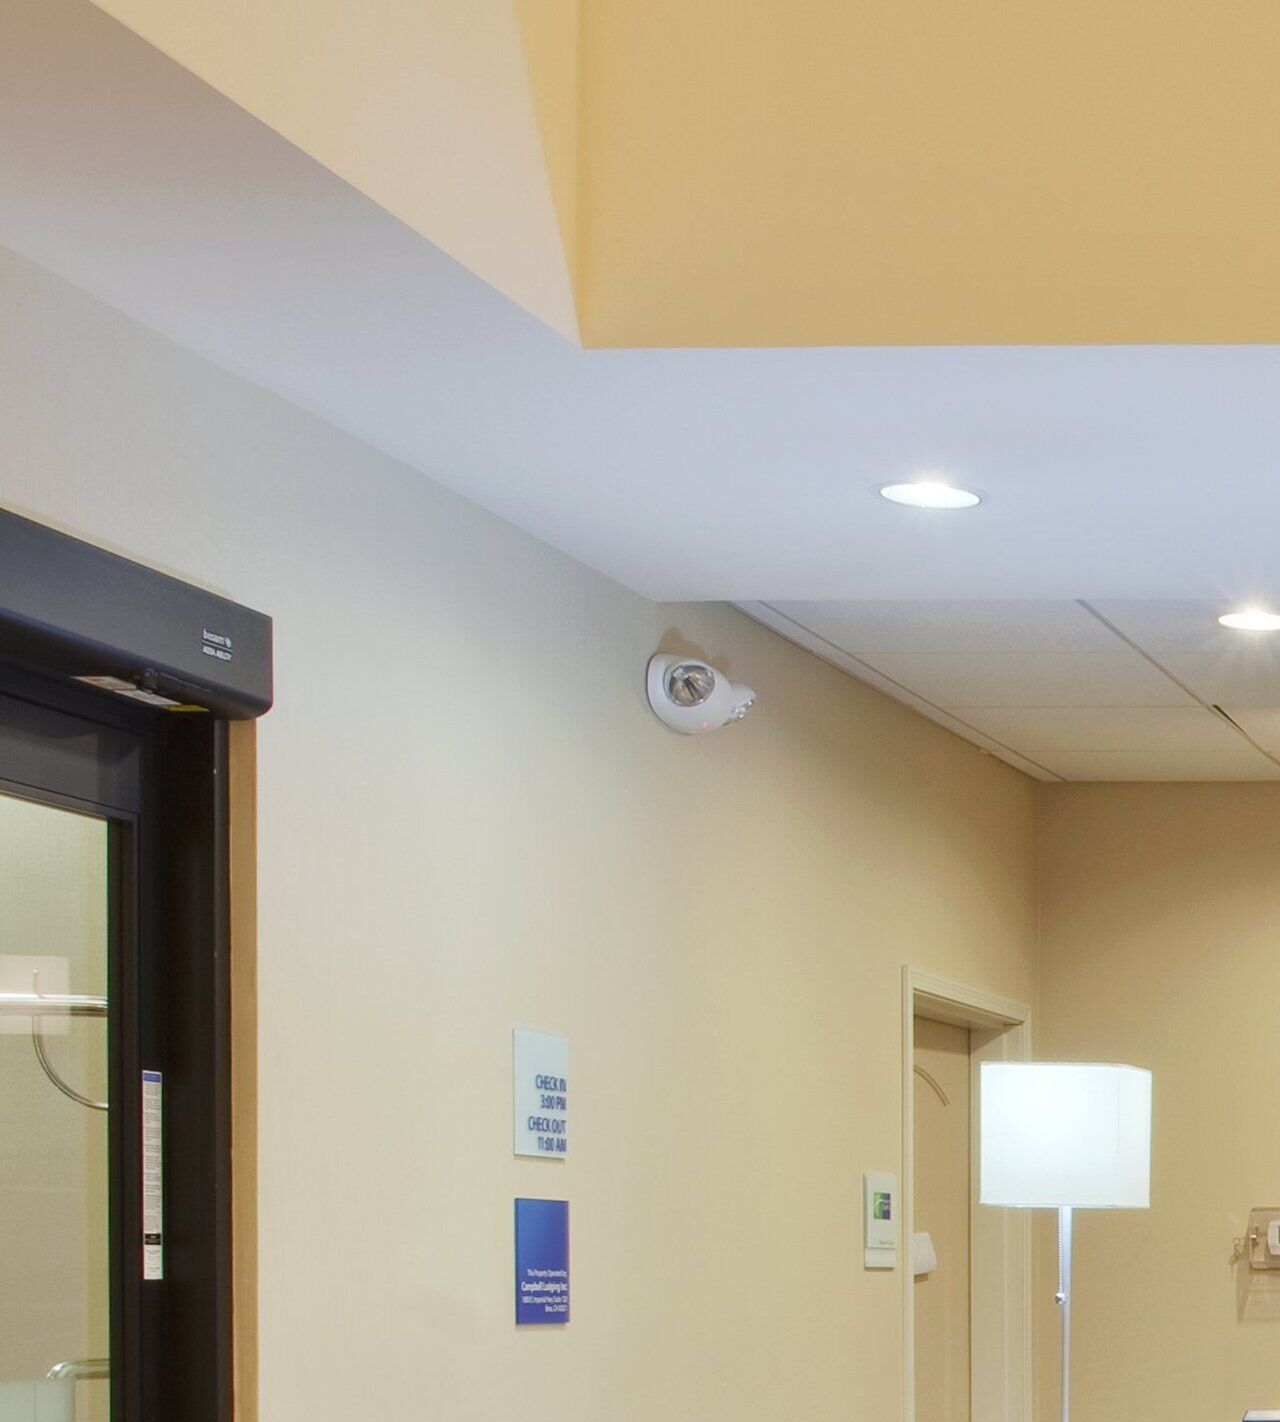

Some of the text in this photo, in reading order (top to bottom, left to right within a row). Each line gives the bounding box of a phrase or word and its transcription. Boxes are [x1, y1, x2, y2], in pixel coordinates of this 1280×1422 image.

[535, 1074, 567, 1092] CHECK IN
[540, 1094, 567, 1110] 3:00 PM
[528, 1116, 567, 1133] CHECK OUT
[537, 1136, 567, 1152] 11:00 AM
